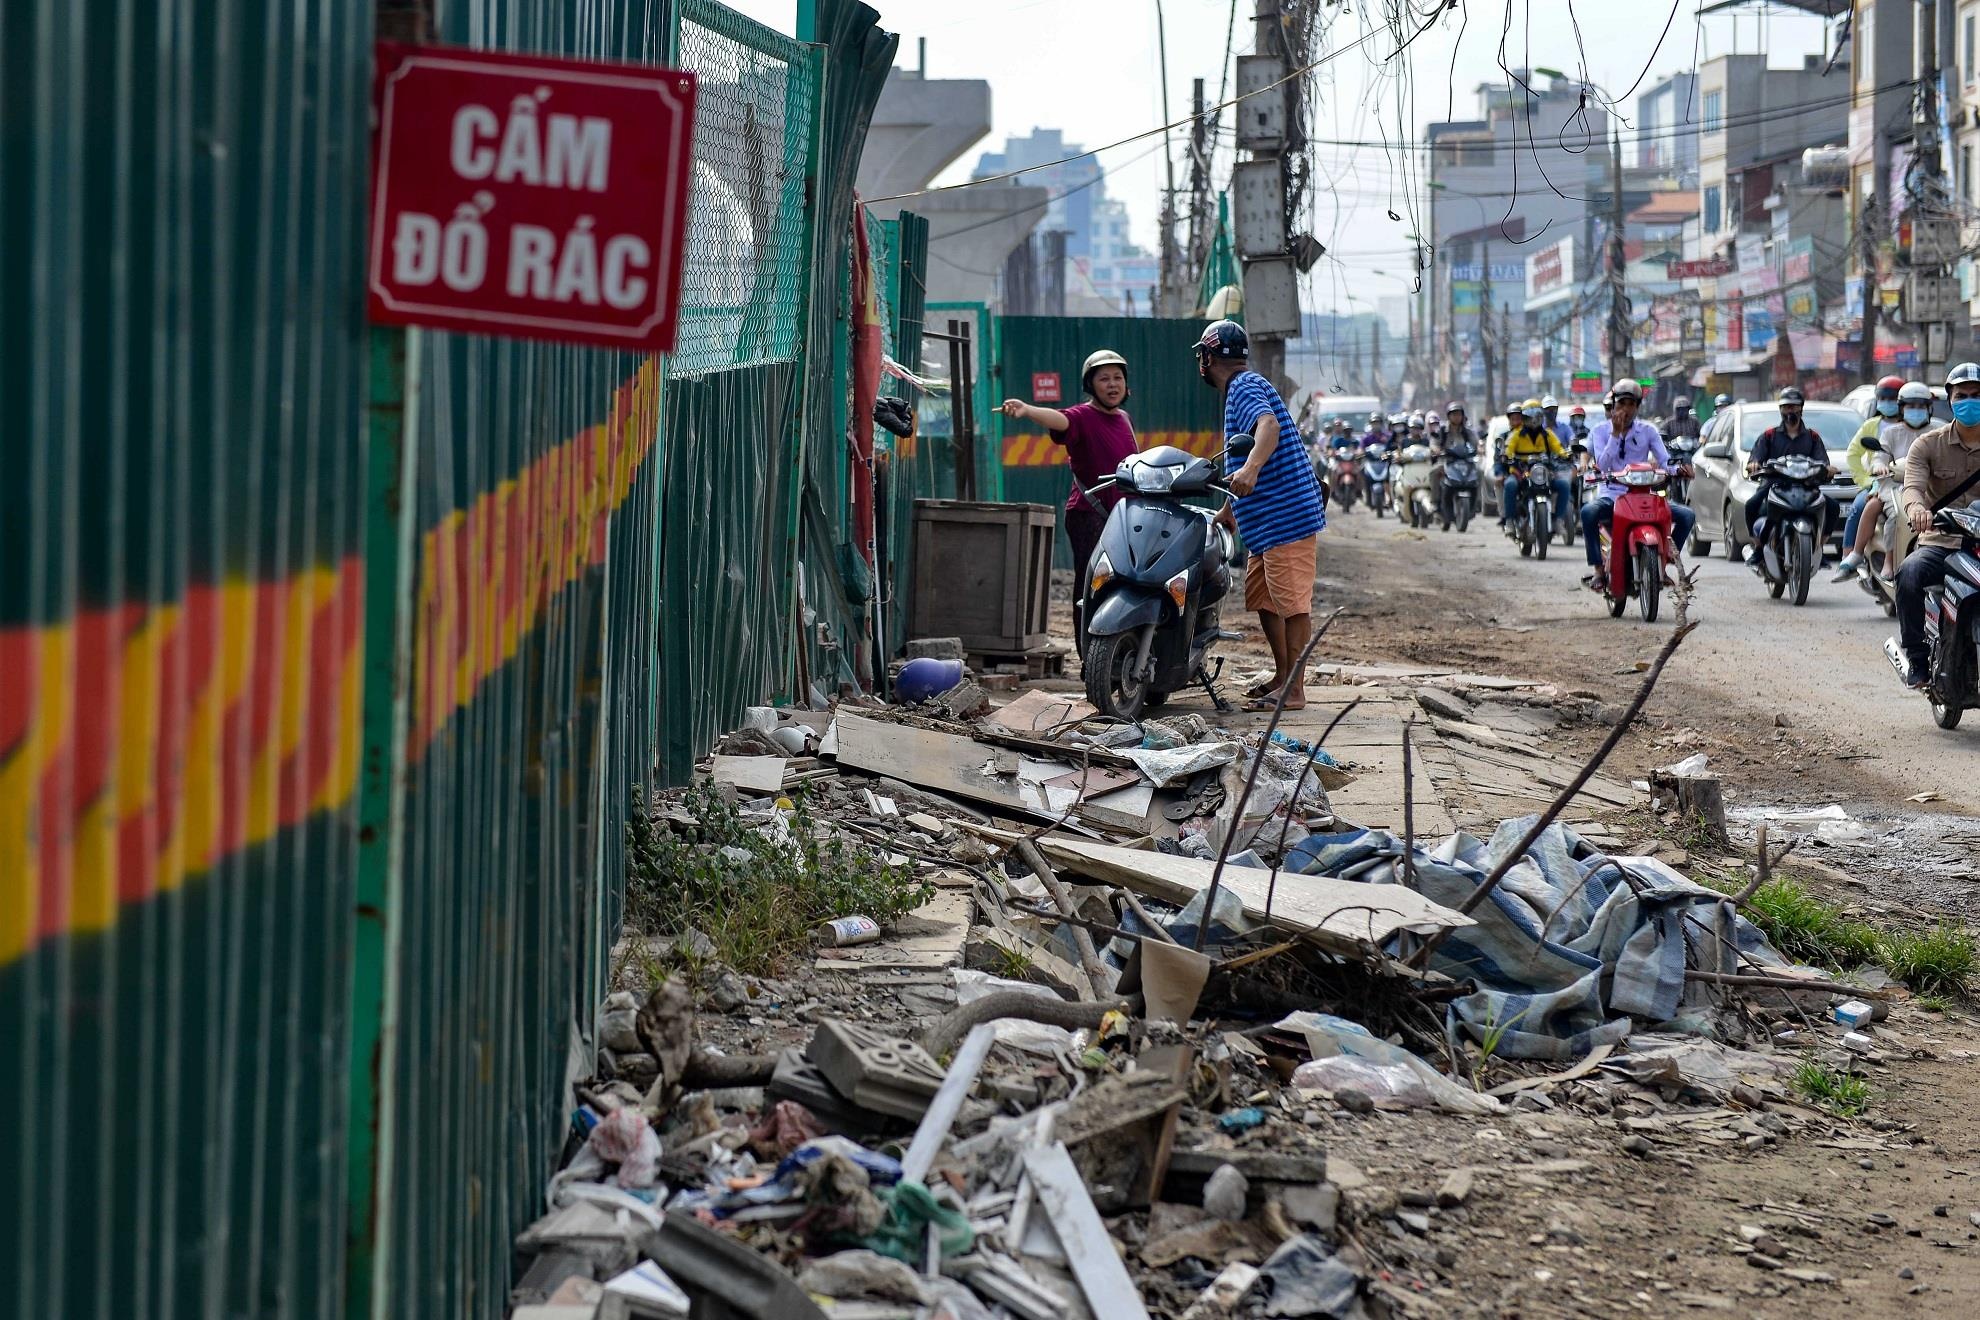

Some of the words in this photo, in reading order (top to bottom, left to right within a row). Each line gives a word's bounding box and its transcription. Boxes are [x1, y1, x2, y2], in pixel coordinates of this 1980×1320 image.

[451, 86, 612, 192] CẤM
[393, 190, 496, 292] ĐỔ
[507, 214, 650, 310] RÁC
